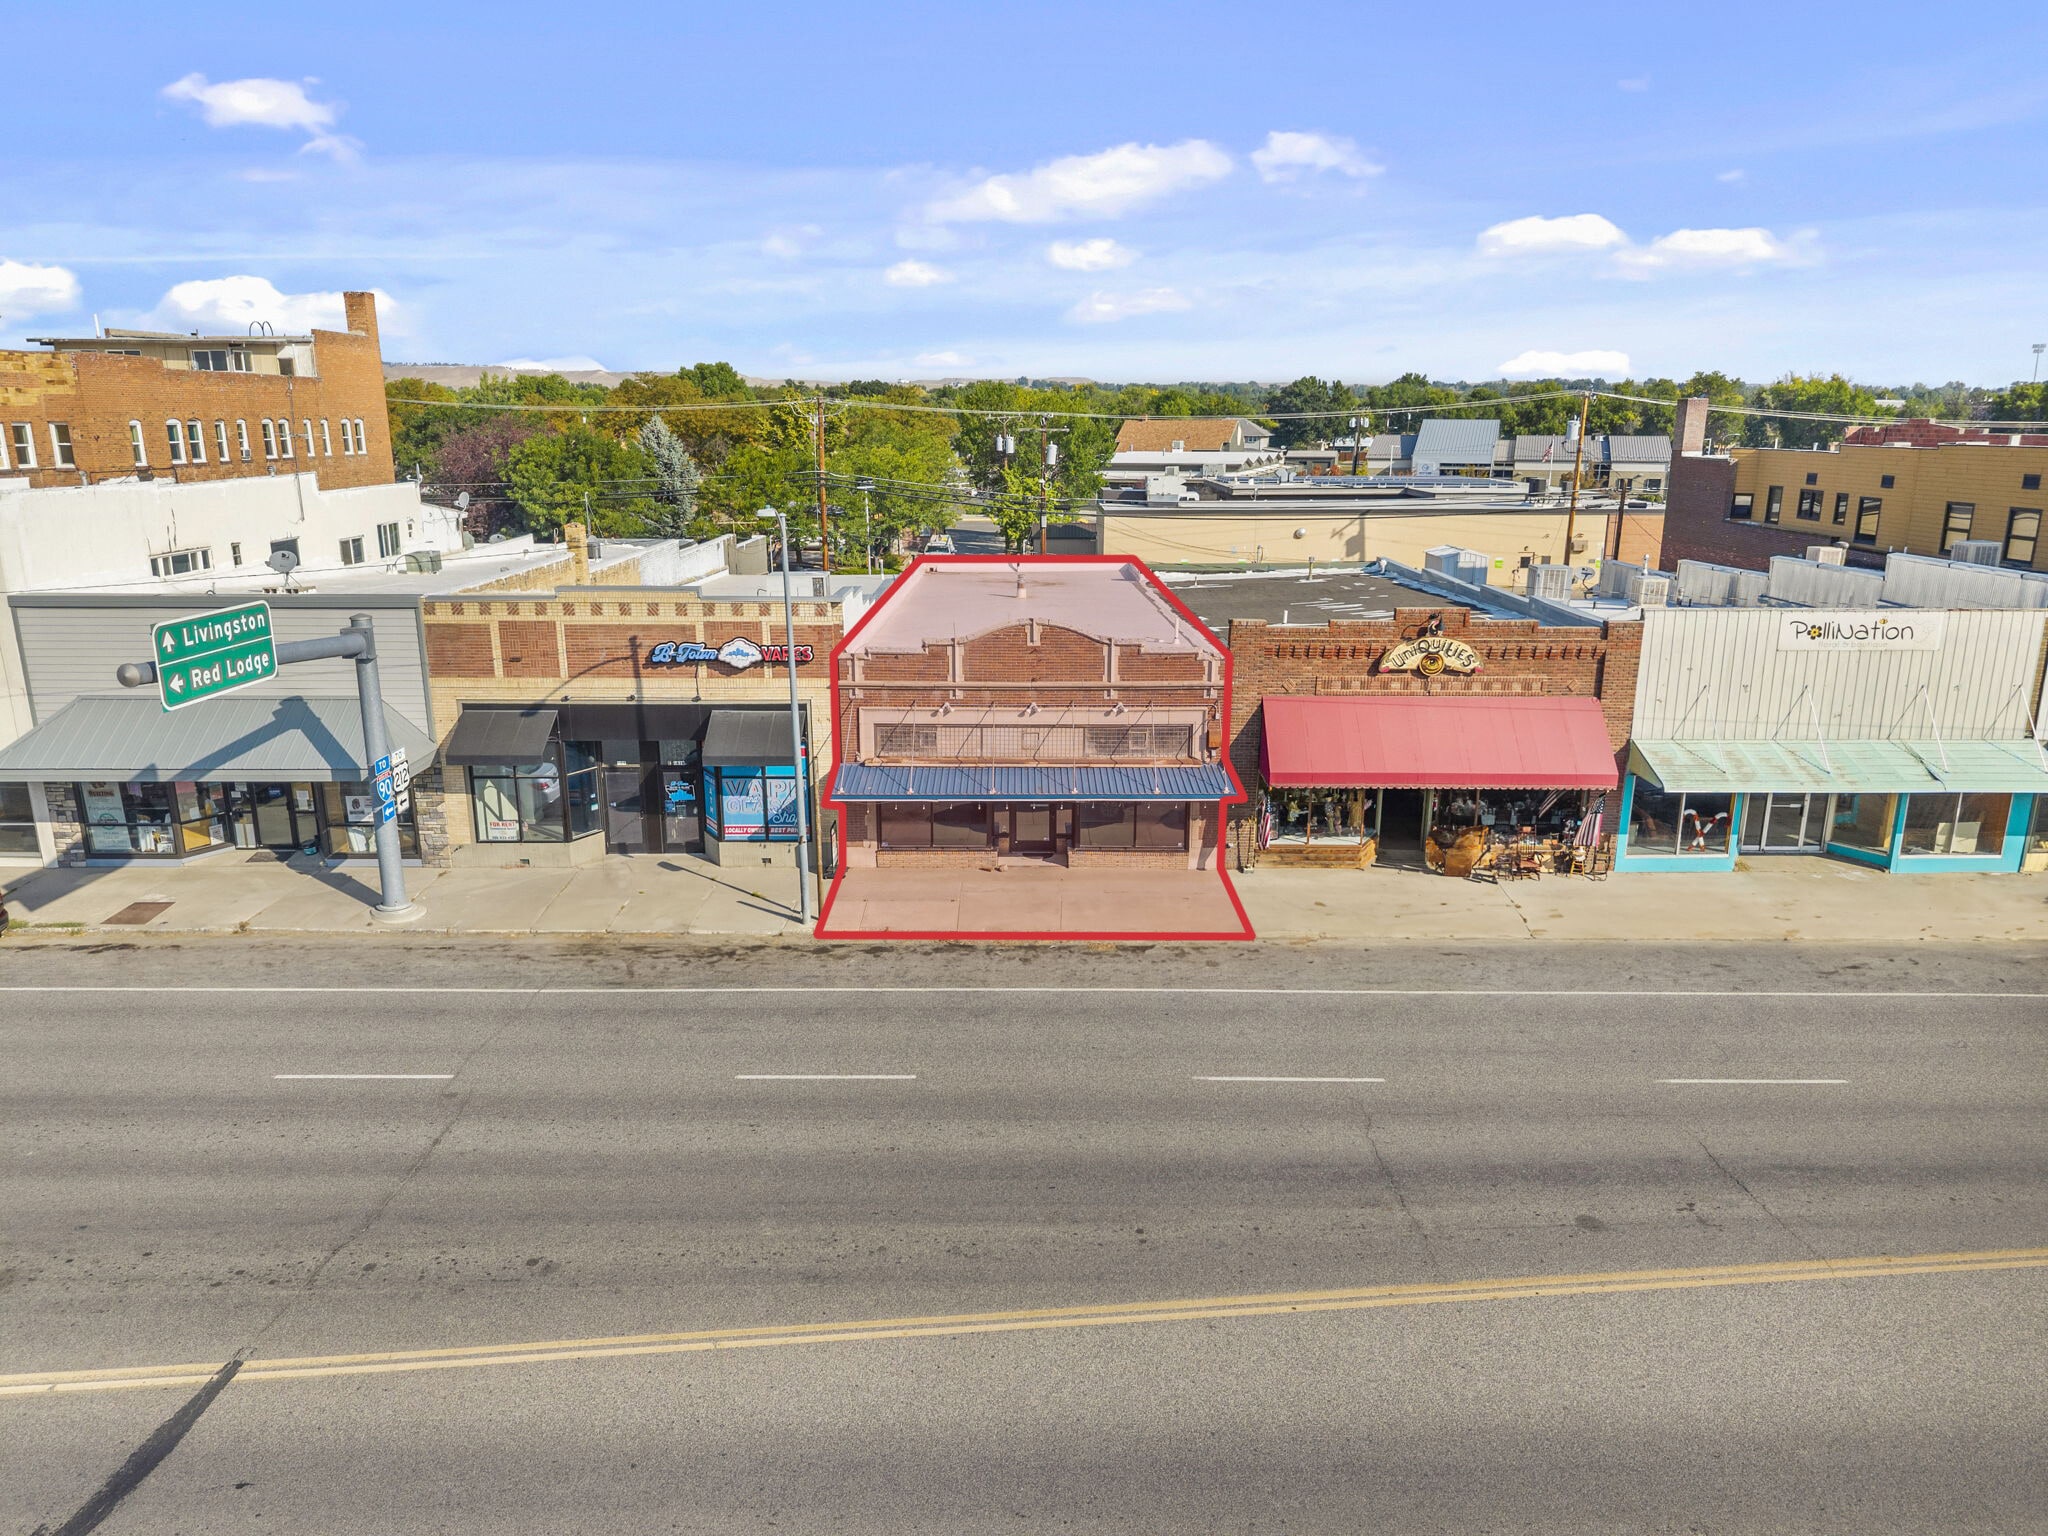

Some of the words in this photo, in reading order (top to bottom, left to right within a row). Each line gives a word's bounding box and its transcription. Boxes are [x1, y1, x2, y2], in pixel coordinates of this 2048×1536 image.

[183, 613, 266, 647] Livingston
[1790, 617, 1914, 641] PolliNation
[652, 641, 718, 663] B-Town
[760, 645, 812, 662] VAPES
[191, 663, 221, 688] Red
[226, 652, 269, 677] Lodge
[378, 759, 387, 769] TO
[379, 779, 392, 797] 90
[395, 768, 409, 788] 212
